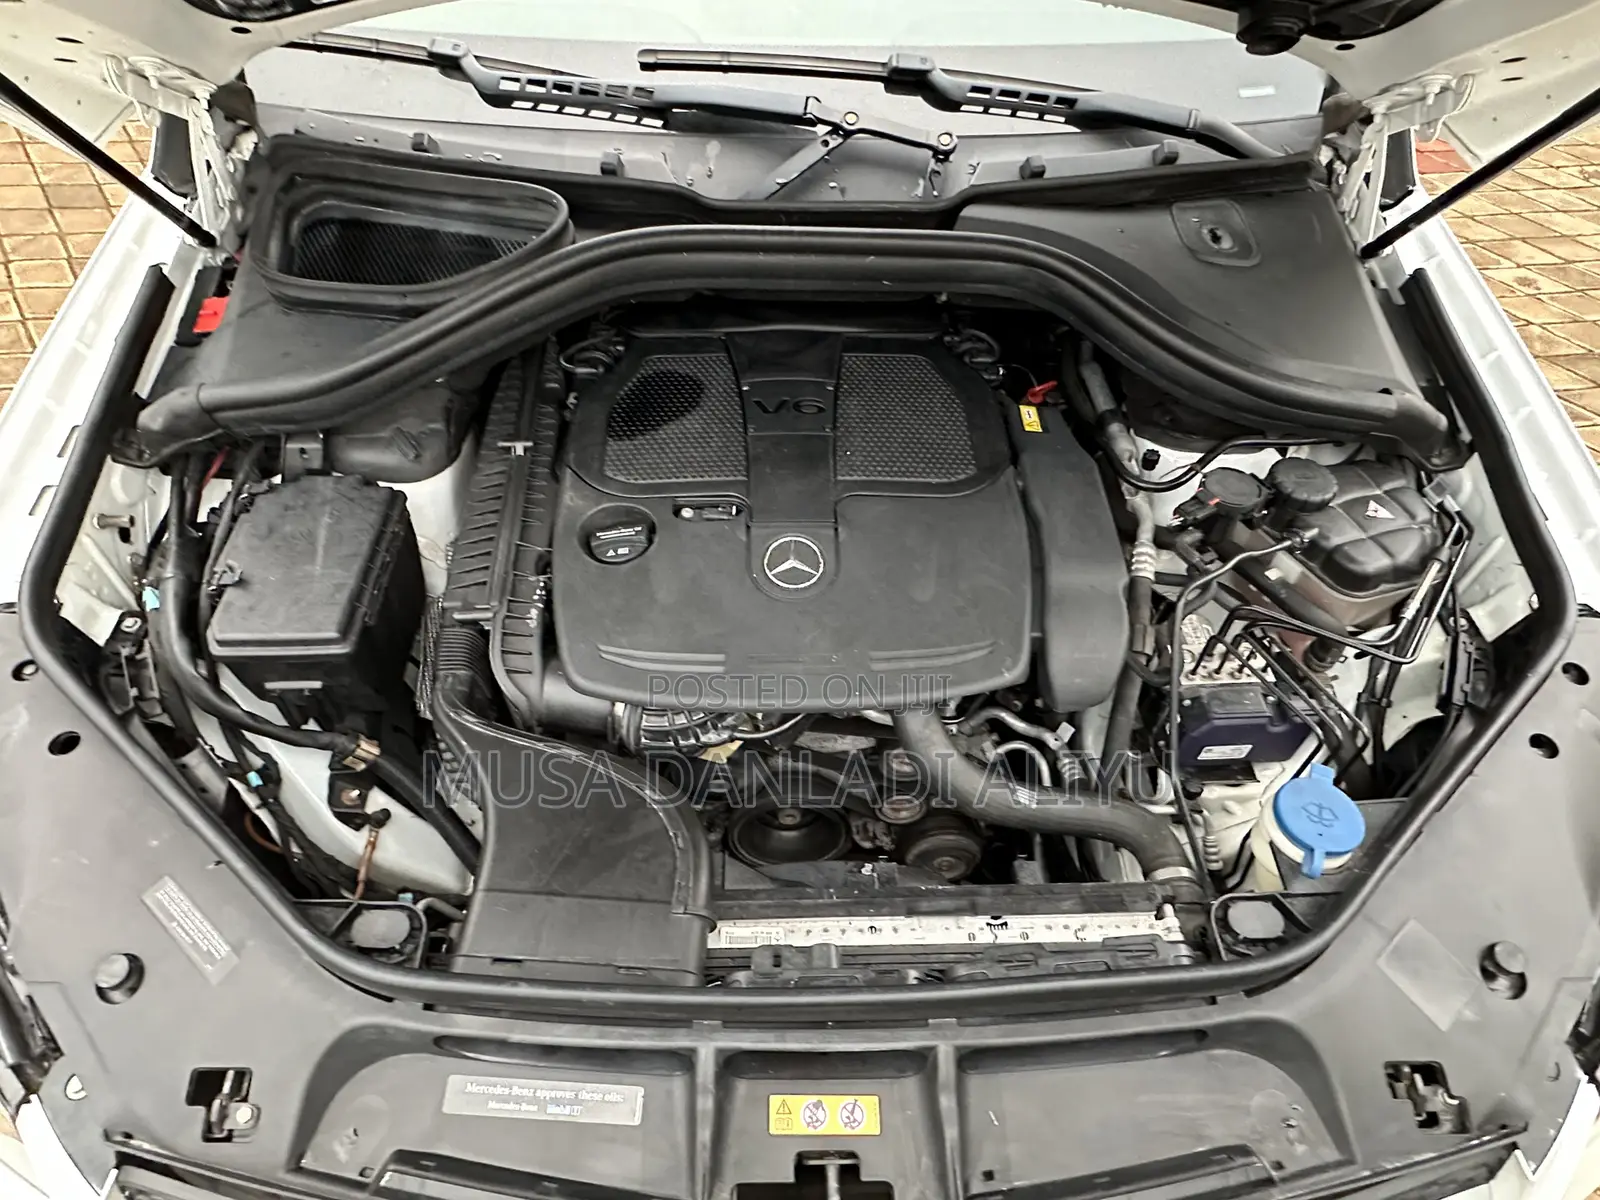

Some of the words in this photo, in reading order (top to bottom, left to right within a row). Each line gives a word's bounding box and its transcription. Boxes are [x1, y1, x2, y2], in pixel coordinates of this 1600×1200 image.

[752, 397, 826, 414] V6
[464, 1082, 535, 1098] Mercedes-Benz
[535, 1087, 577, 1101] approves
[578, 1088, 603, 1102] these
